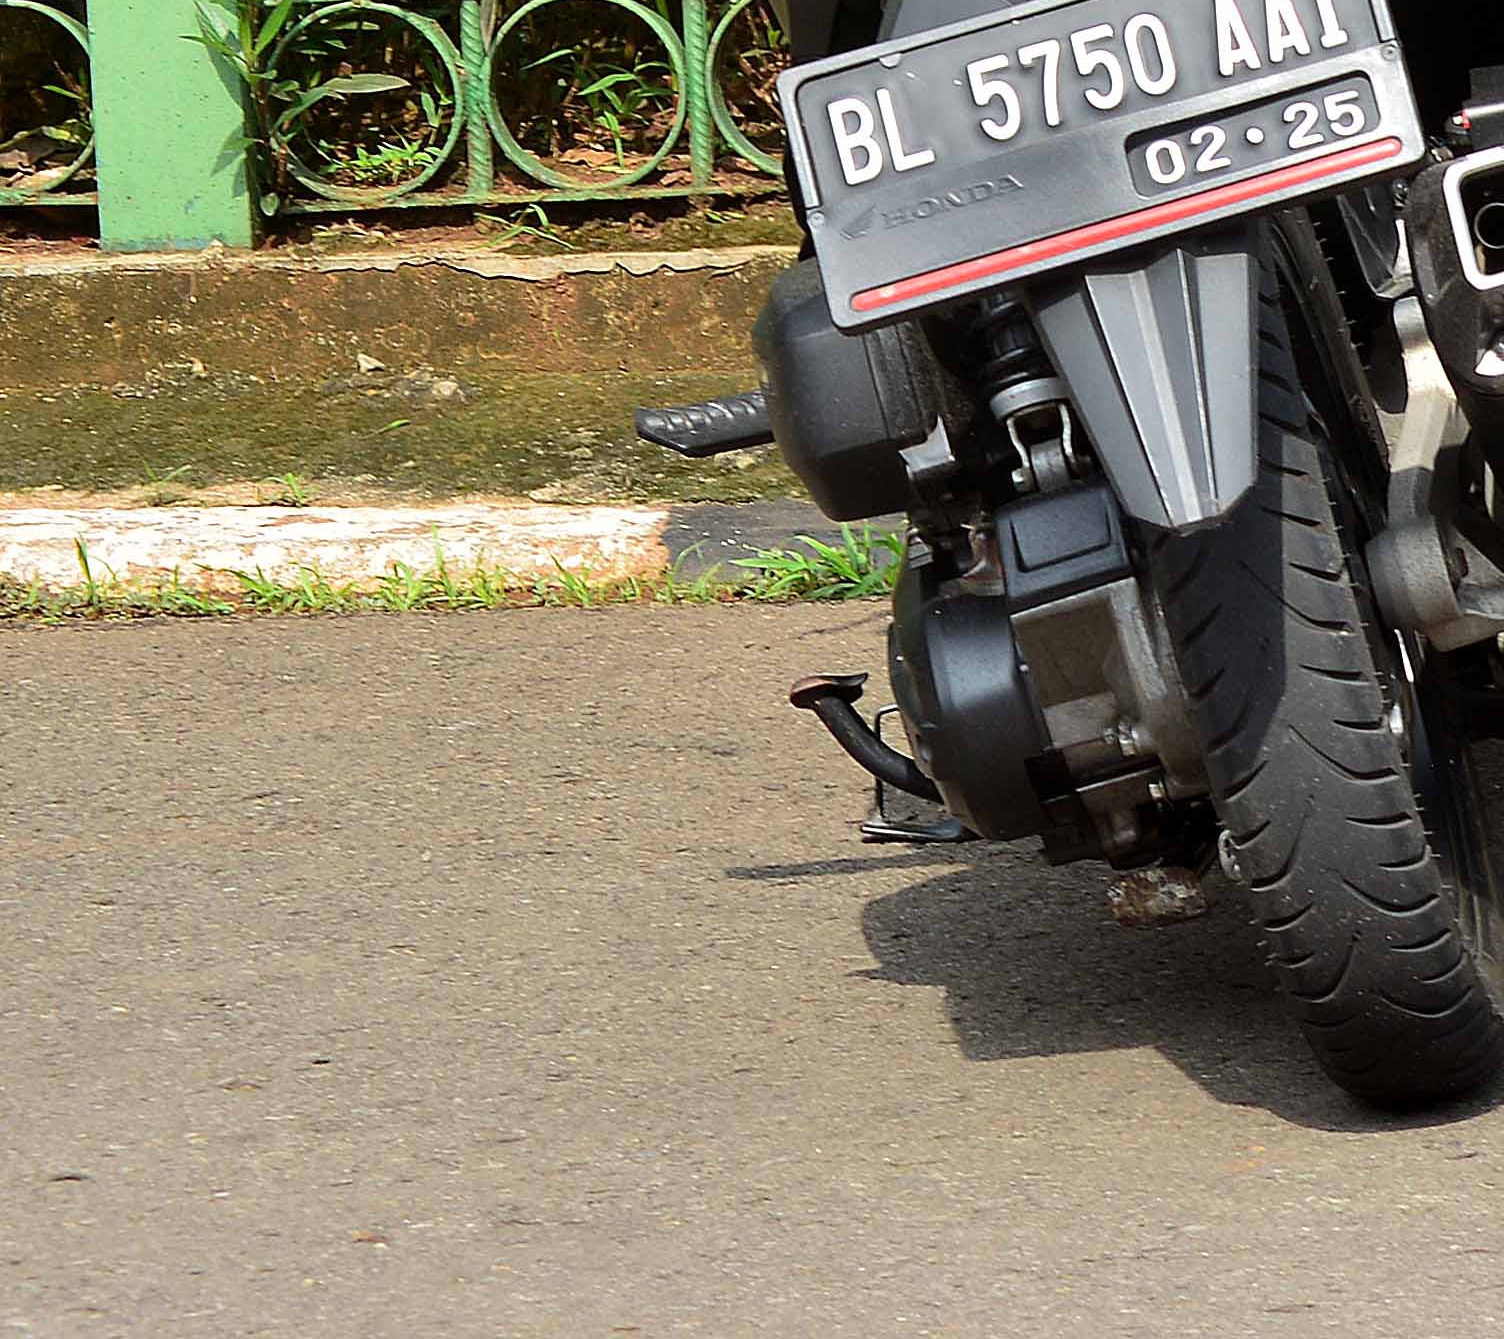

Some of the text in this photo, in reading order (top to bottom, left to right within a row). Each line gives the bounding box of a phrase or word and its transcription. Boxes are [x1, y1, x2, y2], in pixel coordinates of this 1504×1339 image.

[827, 86, 935, 186] BL
[966, 11, 1177, 143] 5750
[882, 173, 1024, 230] HONDA
